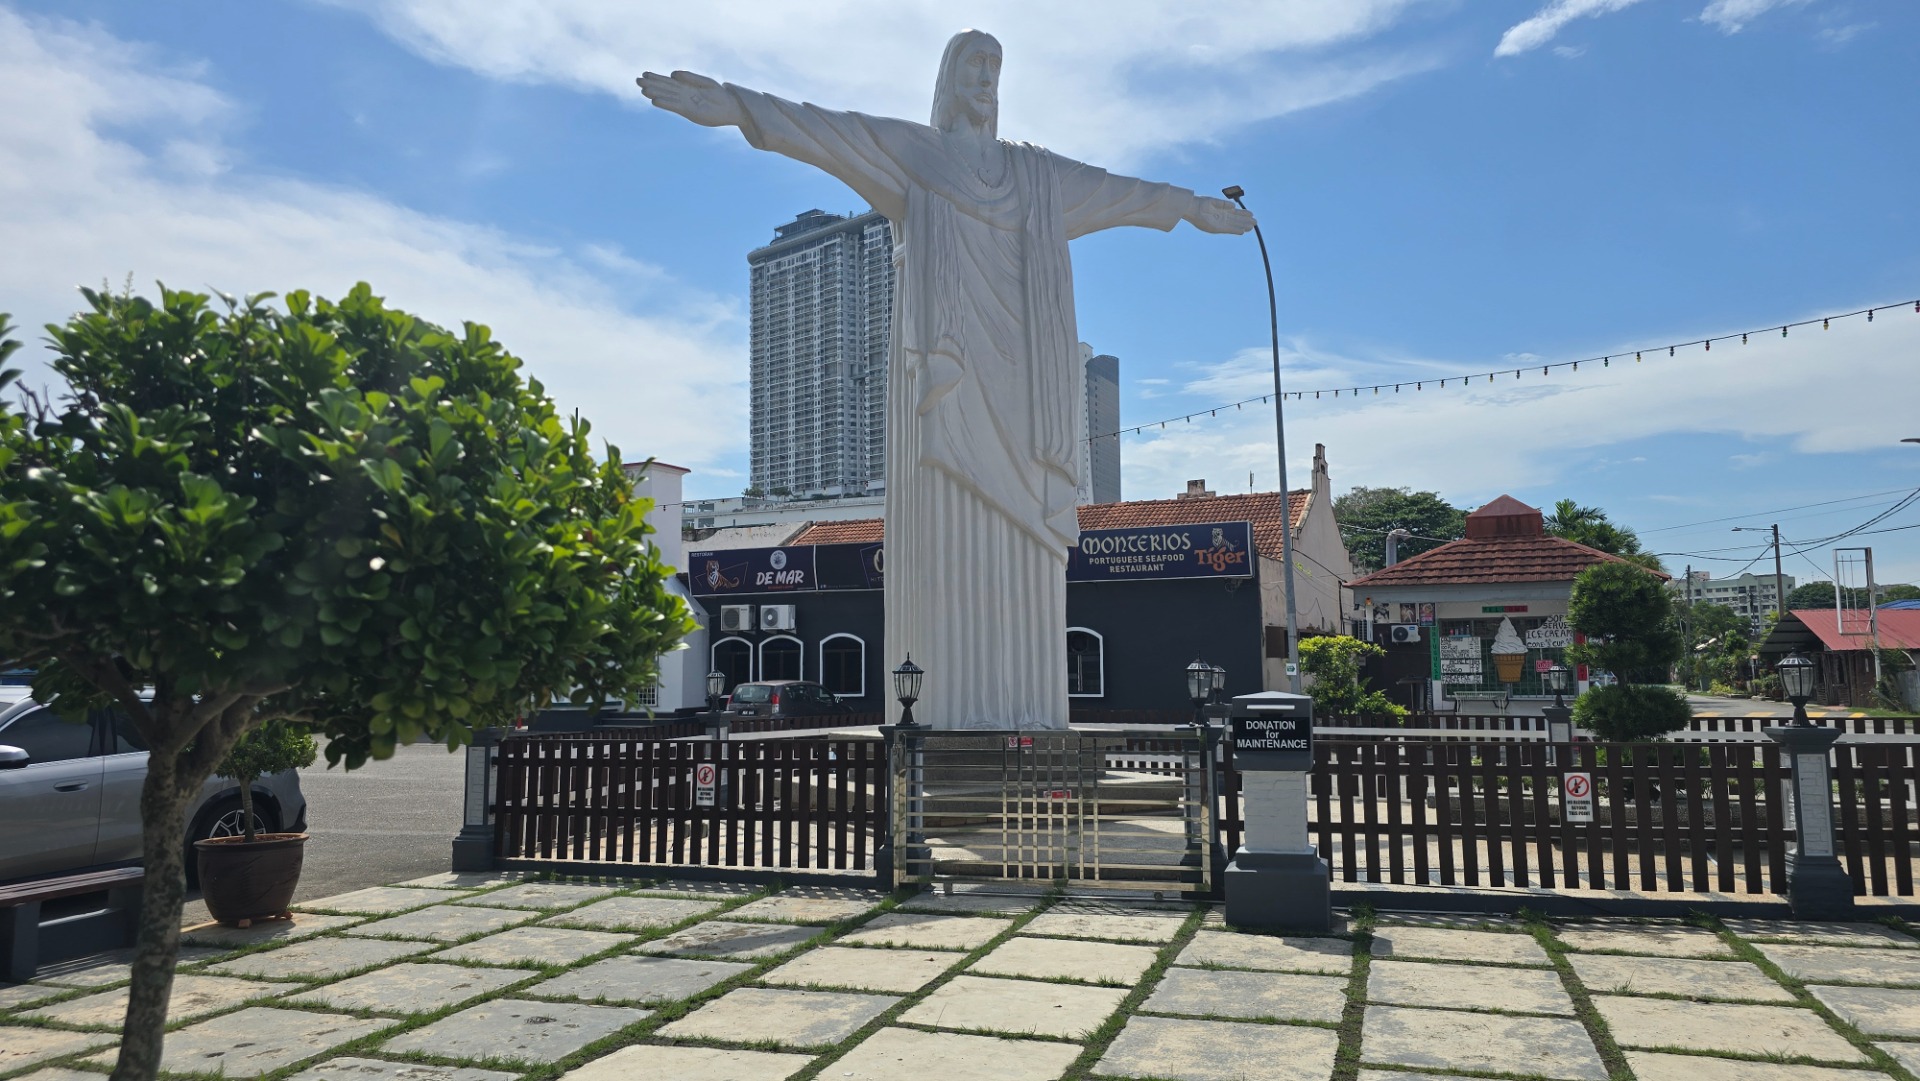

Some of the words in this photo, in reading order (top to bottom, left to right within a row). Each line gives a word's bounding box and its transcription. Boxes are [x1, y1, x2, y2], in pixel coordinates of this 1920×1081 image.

[1082, 532, 1192, 555] MONTERIOS
[1089, 556, 1143, 565] PORTUGUESE
[1146, 553, 1185, 563] SEAFOOD
[1194, 547, 1246, 572] Tiger
[1109, 563, 1165, 573] RESTAURANT
[756, 571, 774, 585] DE
[775, 569, 805, 585] MAR
[1246, 720, 1296, 730] DONATION
[1265, 730, 1279, 739] for
[1237, 739, 1308, 749] MAINTENANCE
